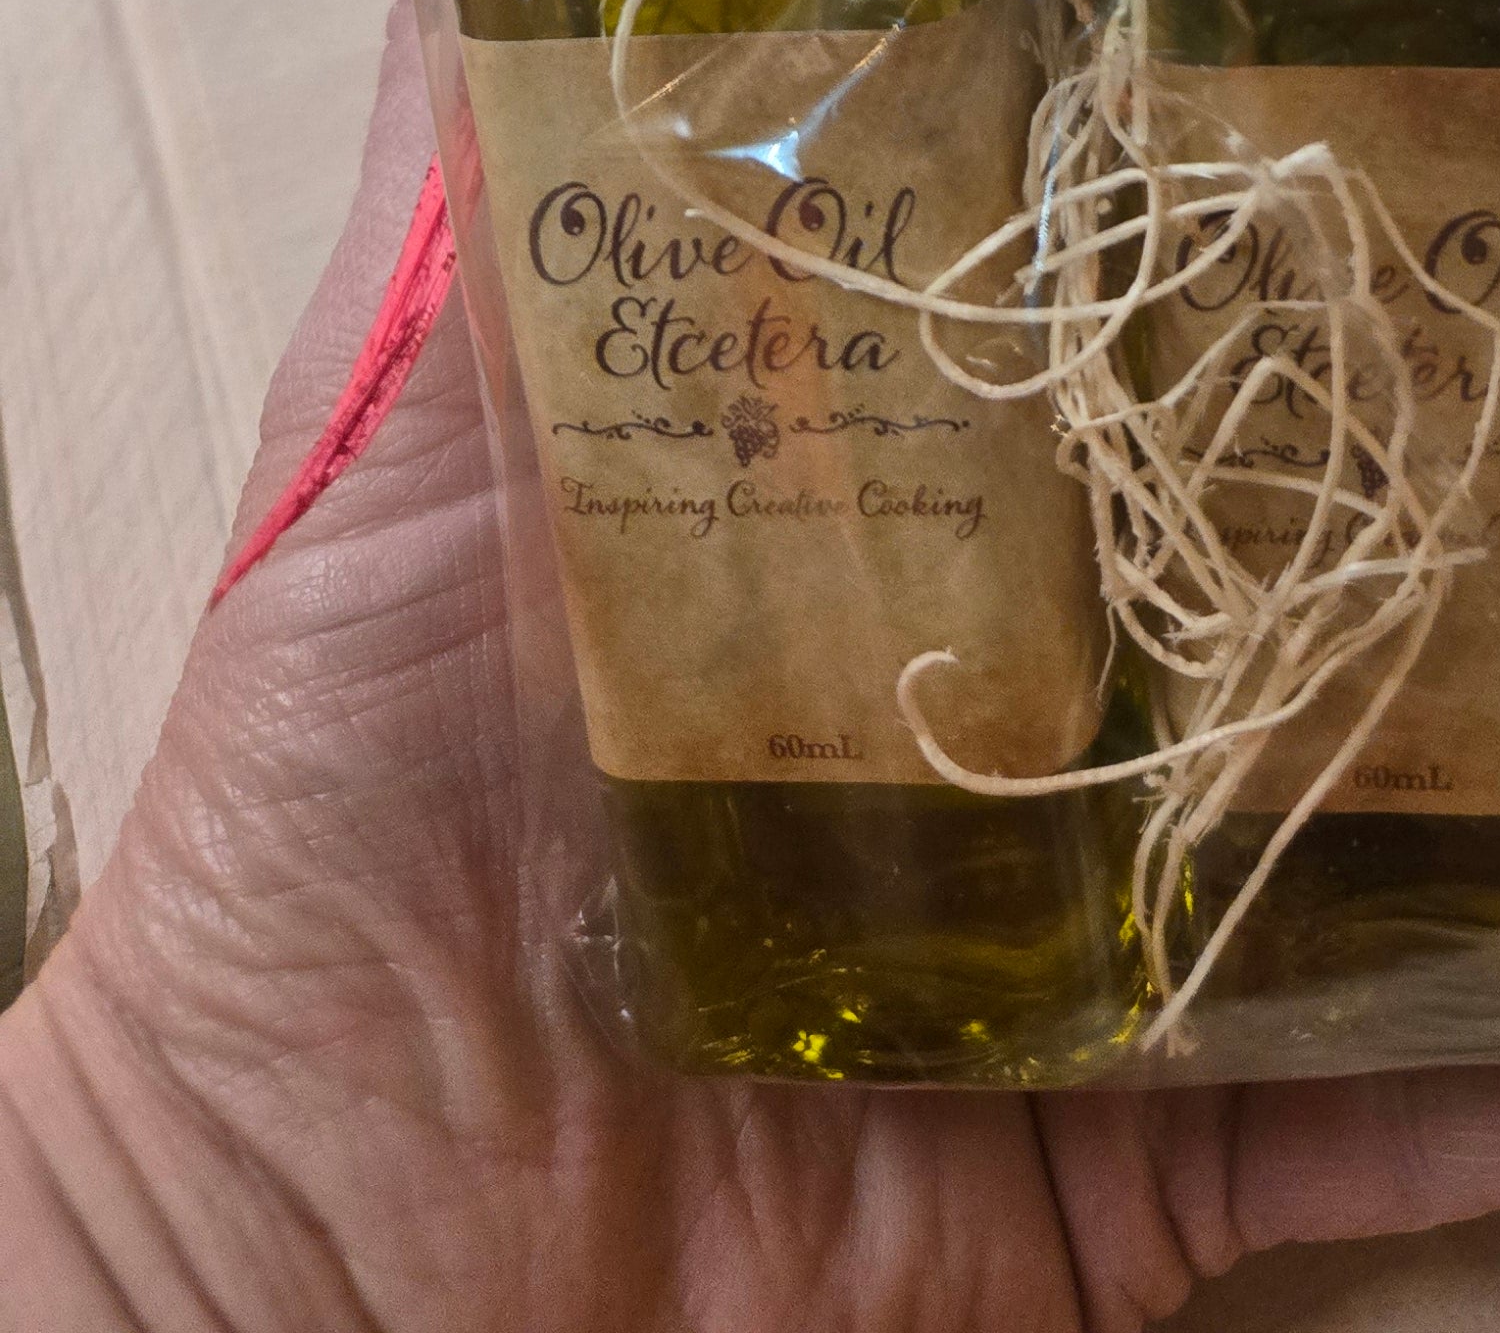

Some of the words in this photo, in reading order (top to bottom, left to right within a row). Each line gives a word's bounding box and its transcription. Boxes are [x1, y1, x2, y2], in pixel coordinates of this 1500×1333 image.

[528, 181, 751, 288] Olive
[764, 176, 916, 286] Oil
[595, 295, 902, 391] Etcetera
[560, 476, 719, 540] Inspiring
[726, 479, 848, 518] Creative
[857, 479, 989, 540] Cooking
[768, 733, 865, 760] 60mL
[1353, 763, 1455, 792] 60mL
